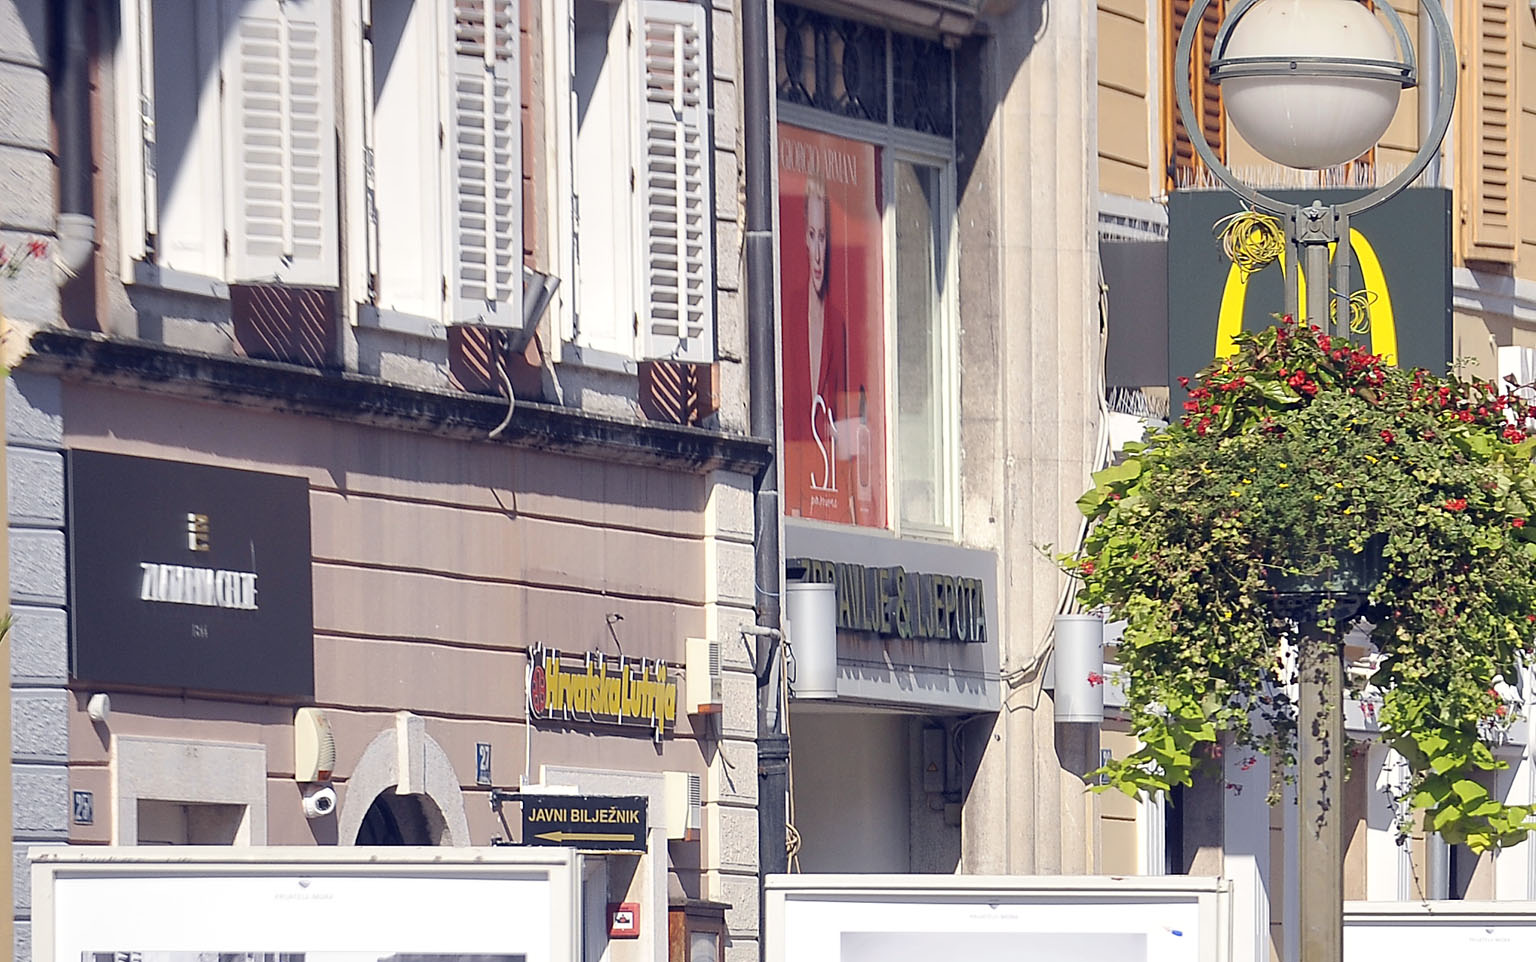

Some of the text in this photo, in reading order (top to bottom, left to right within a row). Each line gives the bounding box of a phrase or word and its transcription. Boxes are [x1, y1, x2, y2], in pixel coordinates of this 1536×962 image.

[917, 572, 988, 642] LJEPOTA
[545, 656, 676, 734] Hrvatska Lutrija
[528, 806, 640, 823] JAVNI BILJEŽNIK
